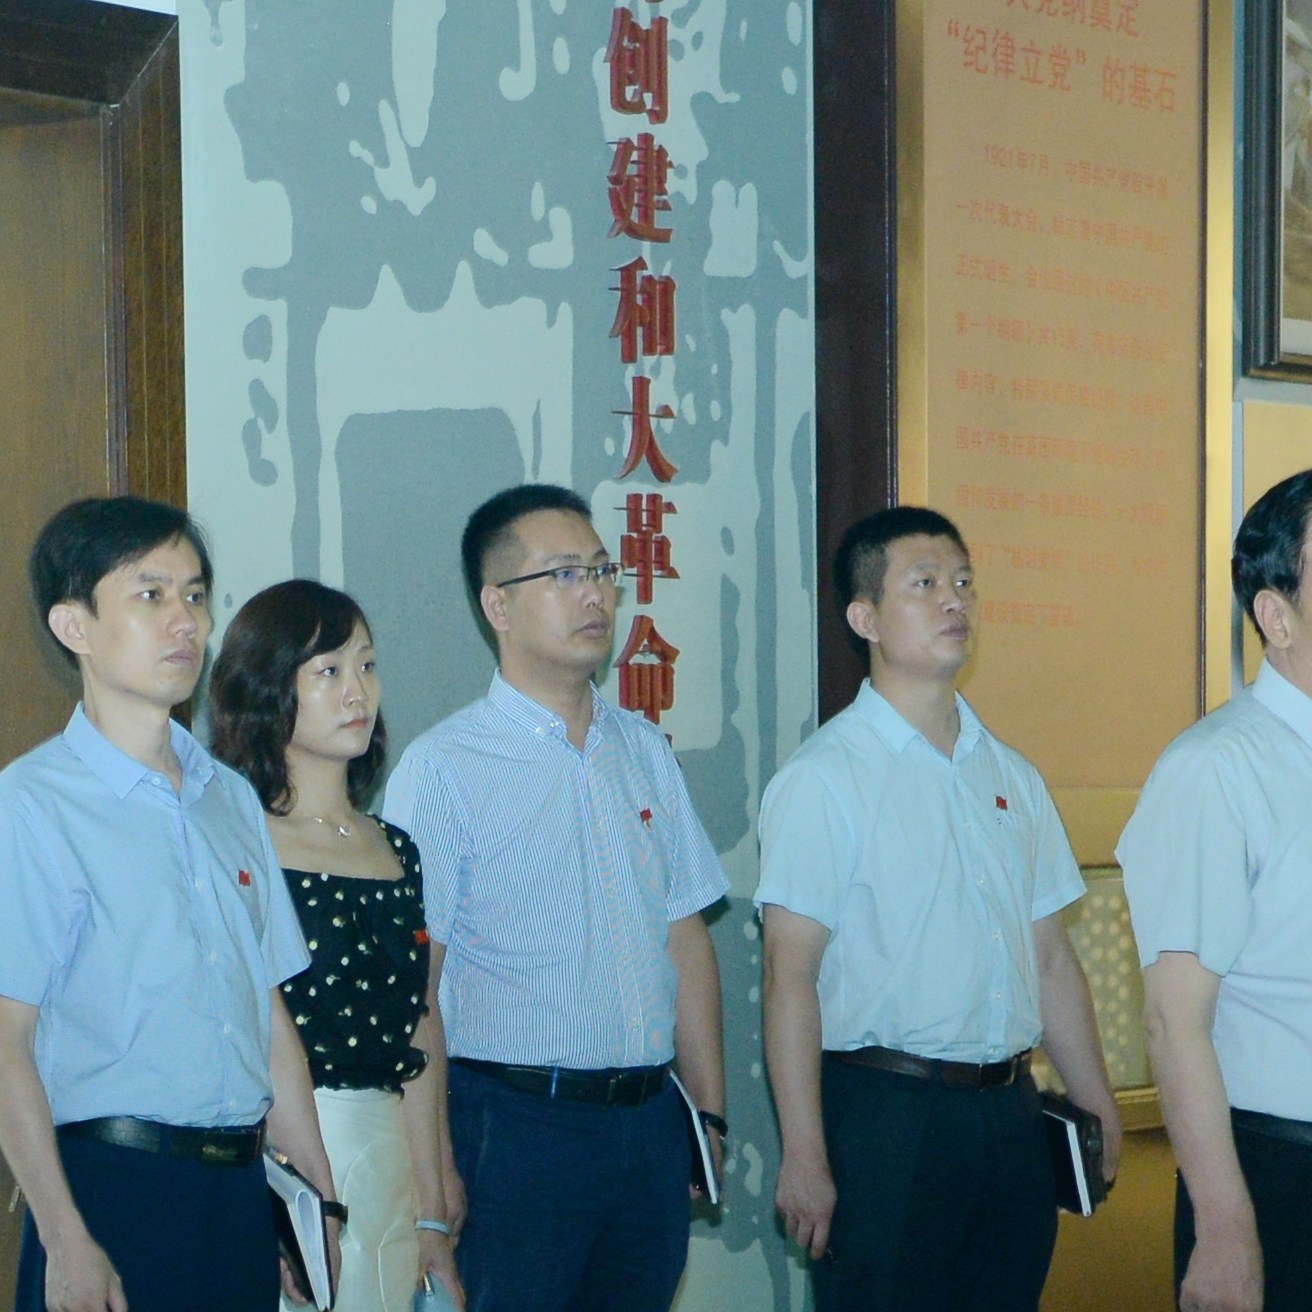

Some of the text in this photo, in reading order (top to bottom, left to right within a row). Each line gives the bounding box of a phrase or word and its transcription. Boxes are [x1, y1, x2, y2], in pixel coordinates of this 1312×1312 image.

[602, 0, 681, 767] 创建和大革命
